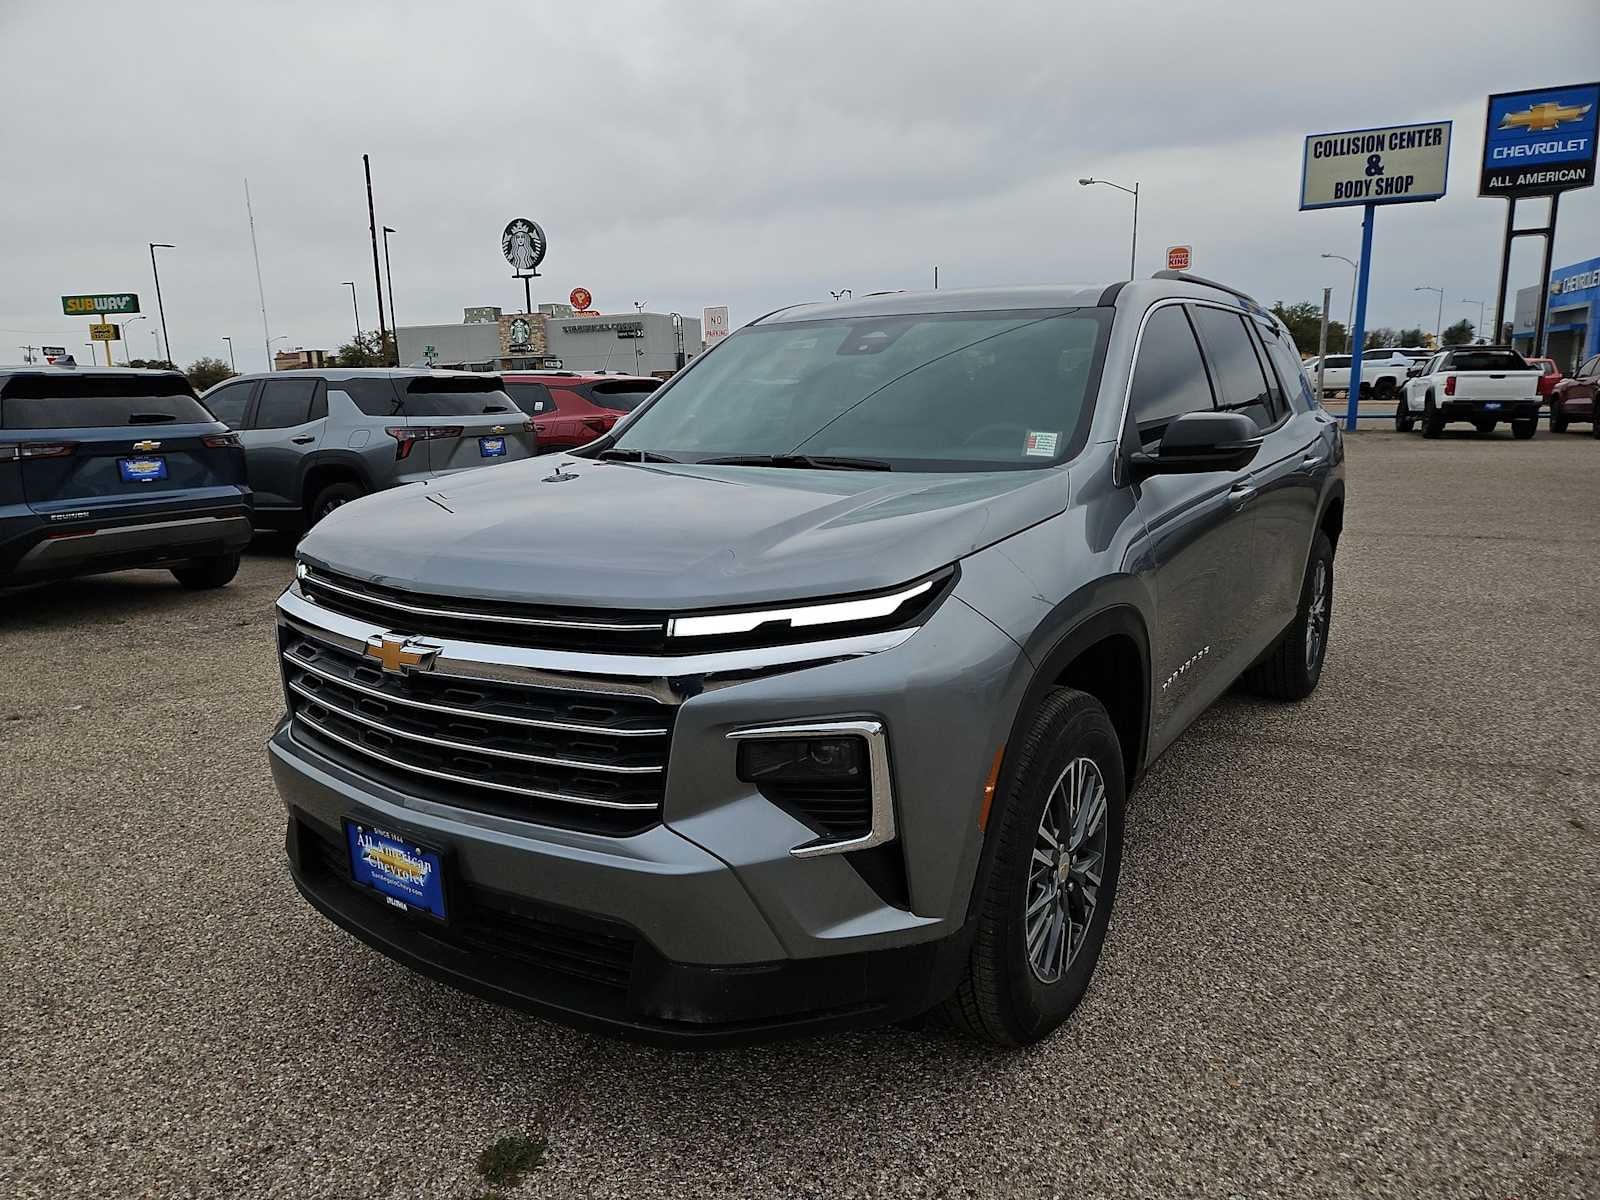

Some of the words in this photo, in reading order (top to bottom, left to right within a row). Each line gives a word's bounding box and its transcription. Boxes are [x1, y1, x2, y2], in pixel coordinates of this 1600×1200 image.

[1313, 134, 1385, 159] COLLISION
[1388, 127, 1442, 150] CENTER
[1492, 138, 1588, 160] CHEVROLET
[1365, 154, 1384, 176] &
[1334, 179, 1373, 199] BODY
[1375, 175, 1413, 195] SHOP
[1489, 175, 1513, 188] ALL
[1516, 168, 1586, 185] AMERICAN
[66, 296, 130, 312] SUBWAY
[711, 316, 721, 324] NO
[357, 833, 373, 849] All
[377, 840, 432, 873] American
[368, 853, 425, 887] Chevrolet
